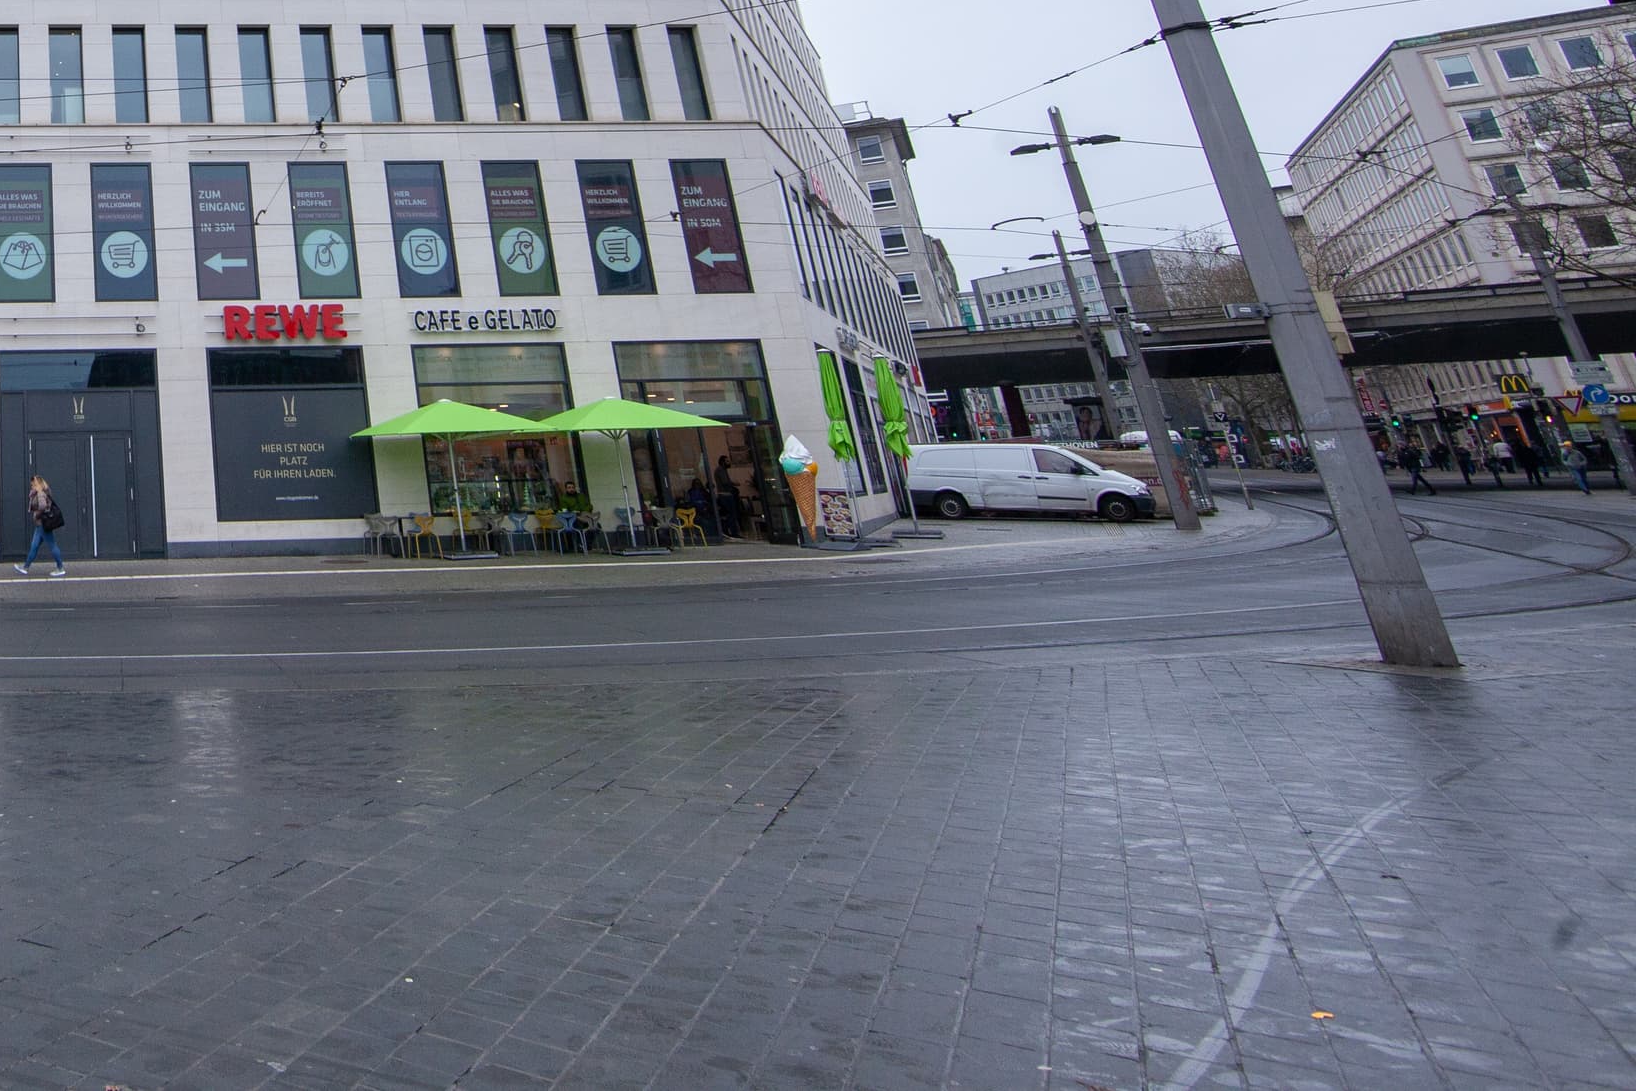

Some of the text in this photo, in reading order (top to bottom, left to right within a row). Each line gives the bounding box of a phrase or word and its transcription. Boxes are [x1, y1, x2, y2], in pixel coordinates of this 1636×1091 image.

[198, 190, 221, 199] ZUM
[490, 189, 511, 197] ALLES
[680, 186, 703, 196] ZUM
[20, 193, 38, 201] WAS
[97, 192, 132, 200] HERZLICH
[8, 202, 42, 210] BRAUCHEN
[97, 201, 142, 209] WILLKOMMEN
[199, 201, 246, 212] EINGANG
[683, 198, 728, 207] EINGANG
[200, 222, 212, 232] IN
[687, 218, 698, 227] IN
[223, 304, 348, 342] REWE
[414, 308, 558, 331] CAFE e GELATO
[260, 443, 325, 453] HIER IST NOCH
[280, 456, 308, 466] PLATZ
[253, 468, 273, 479] FÜR
[274, 469, 302, 479] IHREN
